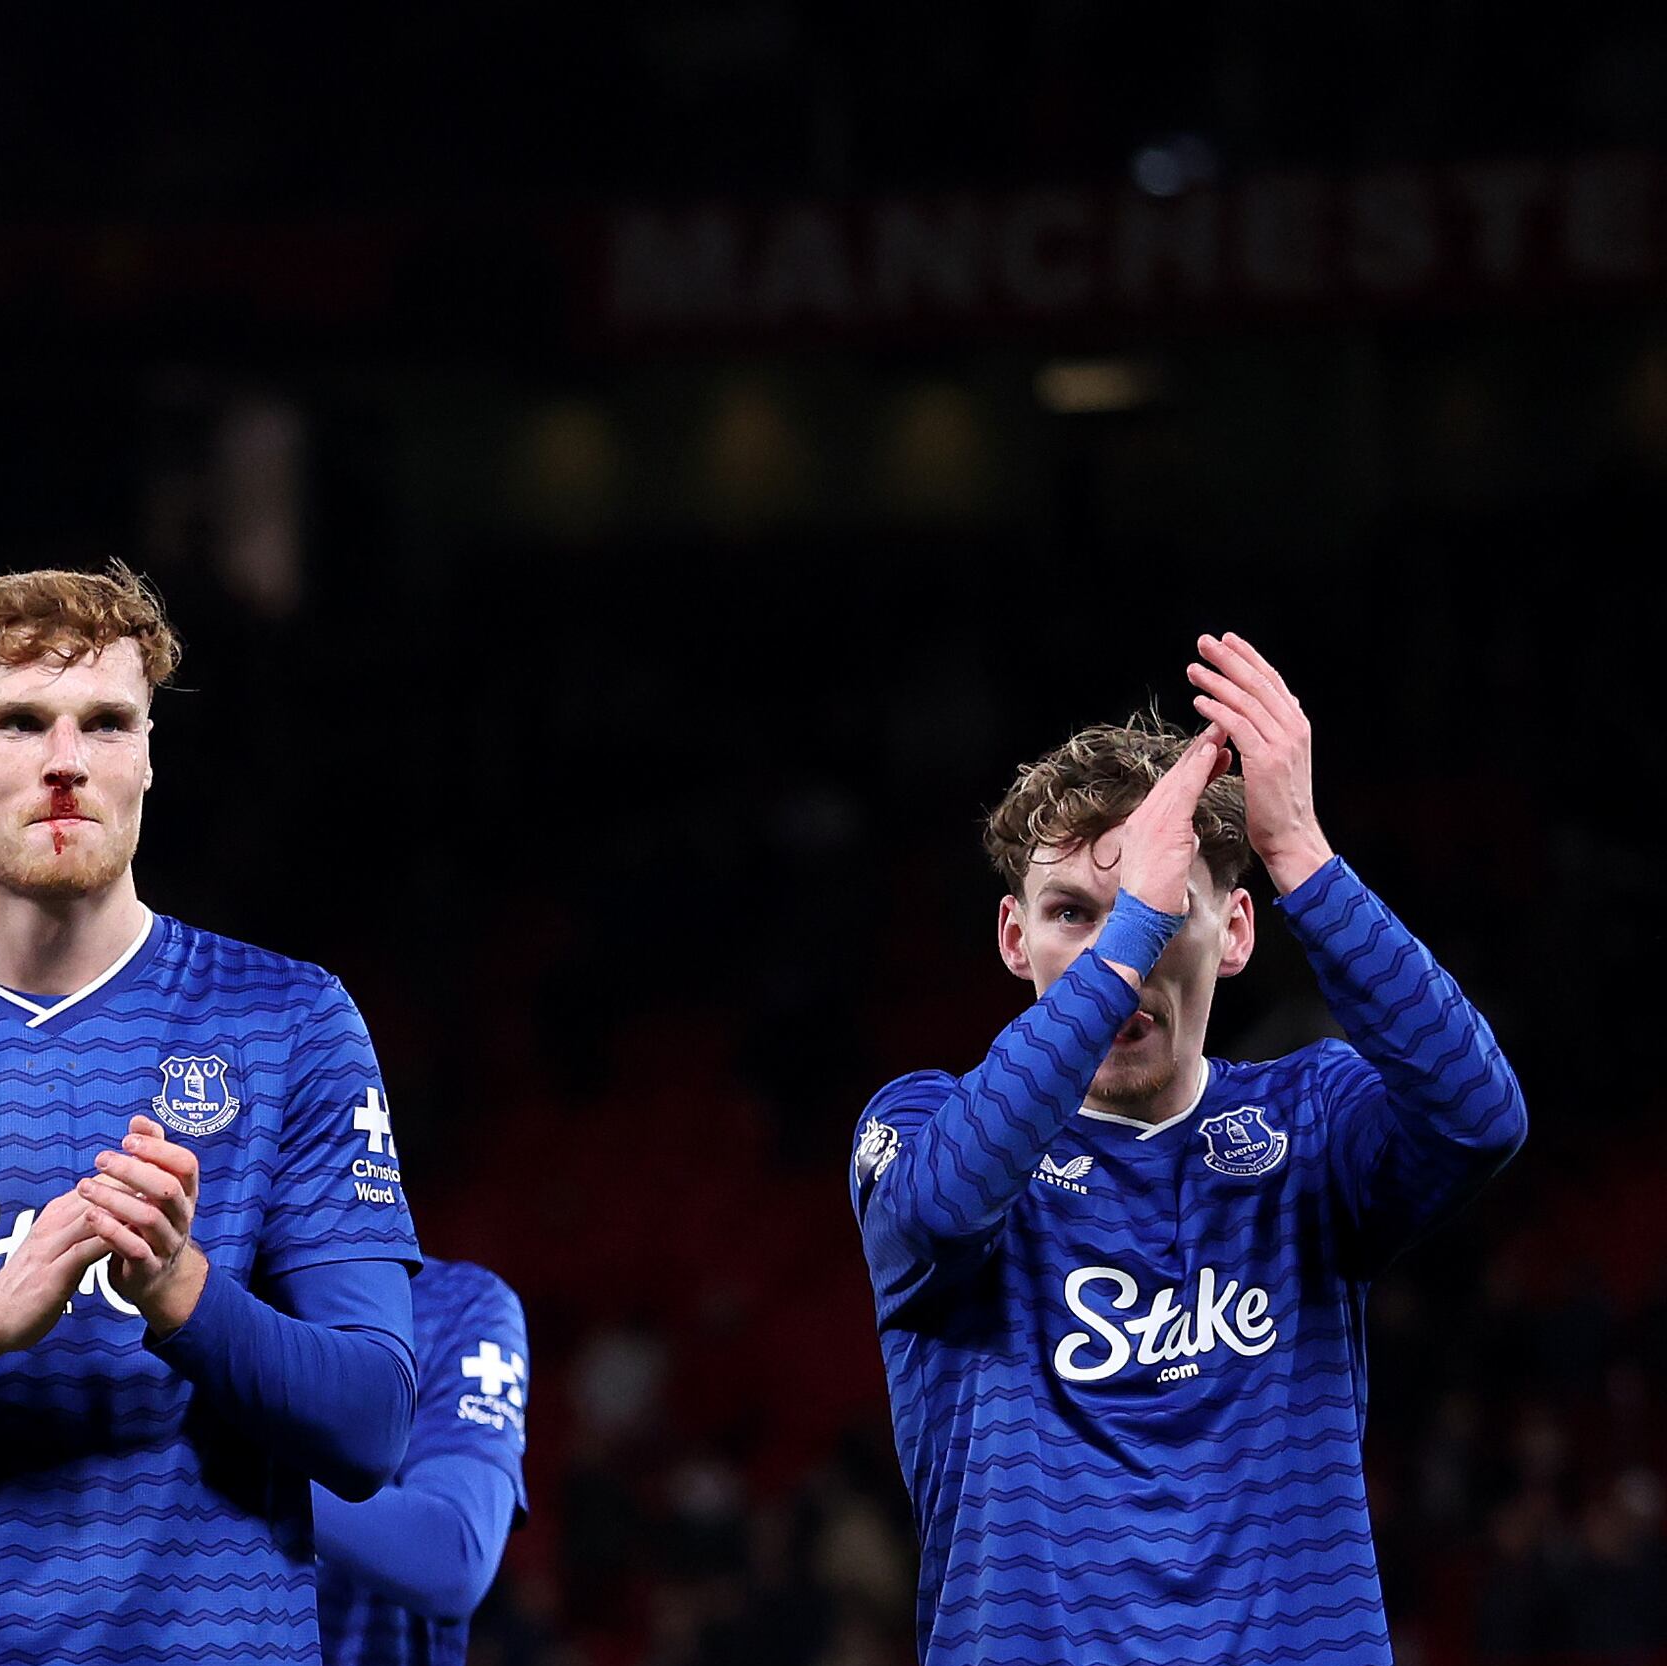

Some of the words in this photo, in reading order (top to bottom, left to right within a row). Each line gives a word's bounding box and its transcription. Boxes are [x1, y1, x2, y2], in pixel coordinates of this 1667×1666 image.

[172, 1099, 219, 1111] Everton
[1224, 1141, 1267, 1160] Everton
[354, 1181, 396, 1204] Ward
[1053, 1266, 1277, 1381] Stake
[1156, 1362, 1200, 1383] .com
